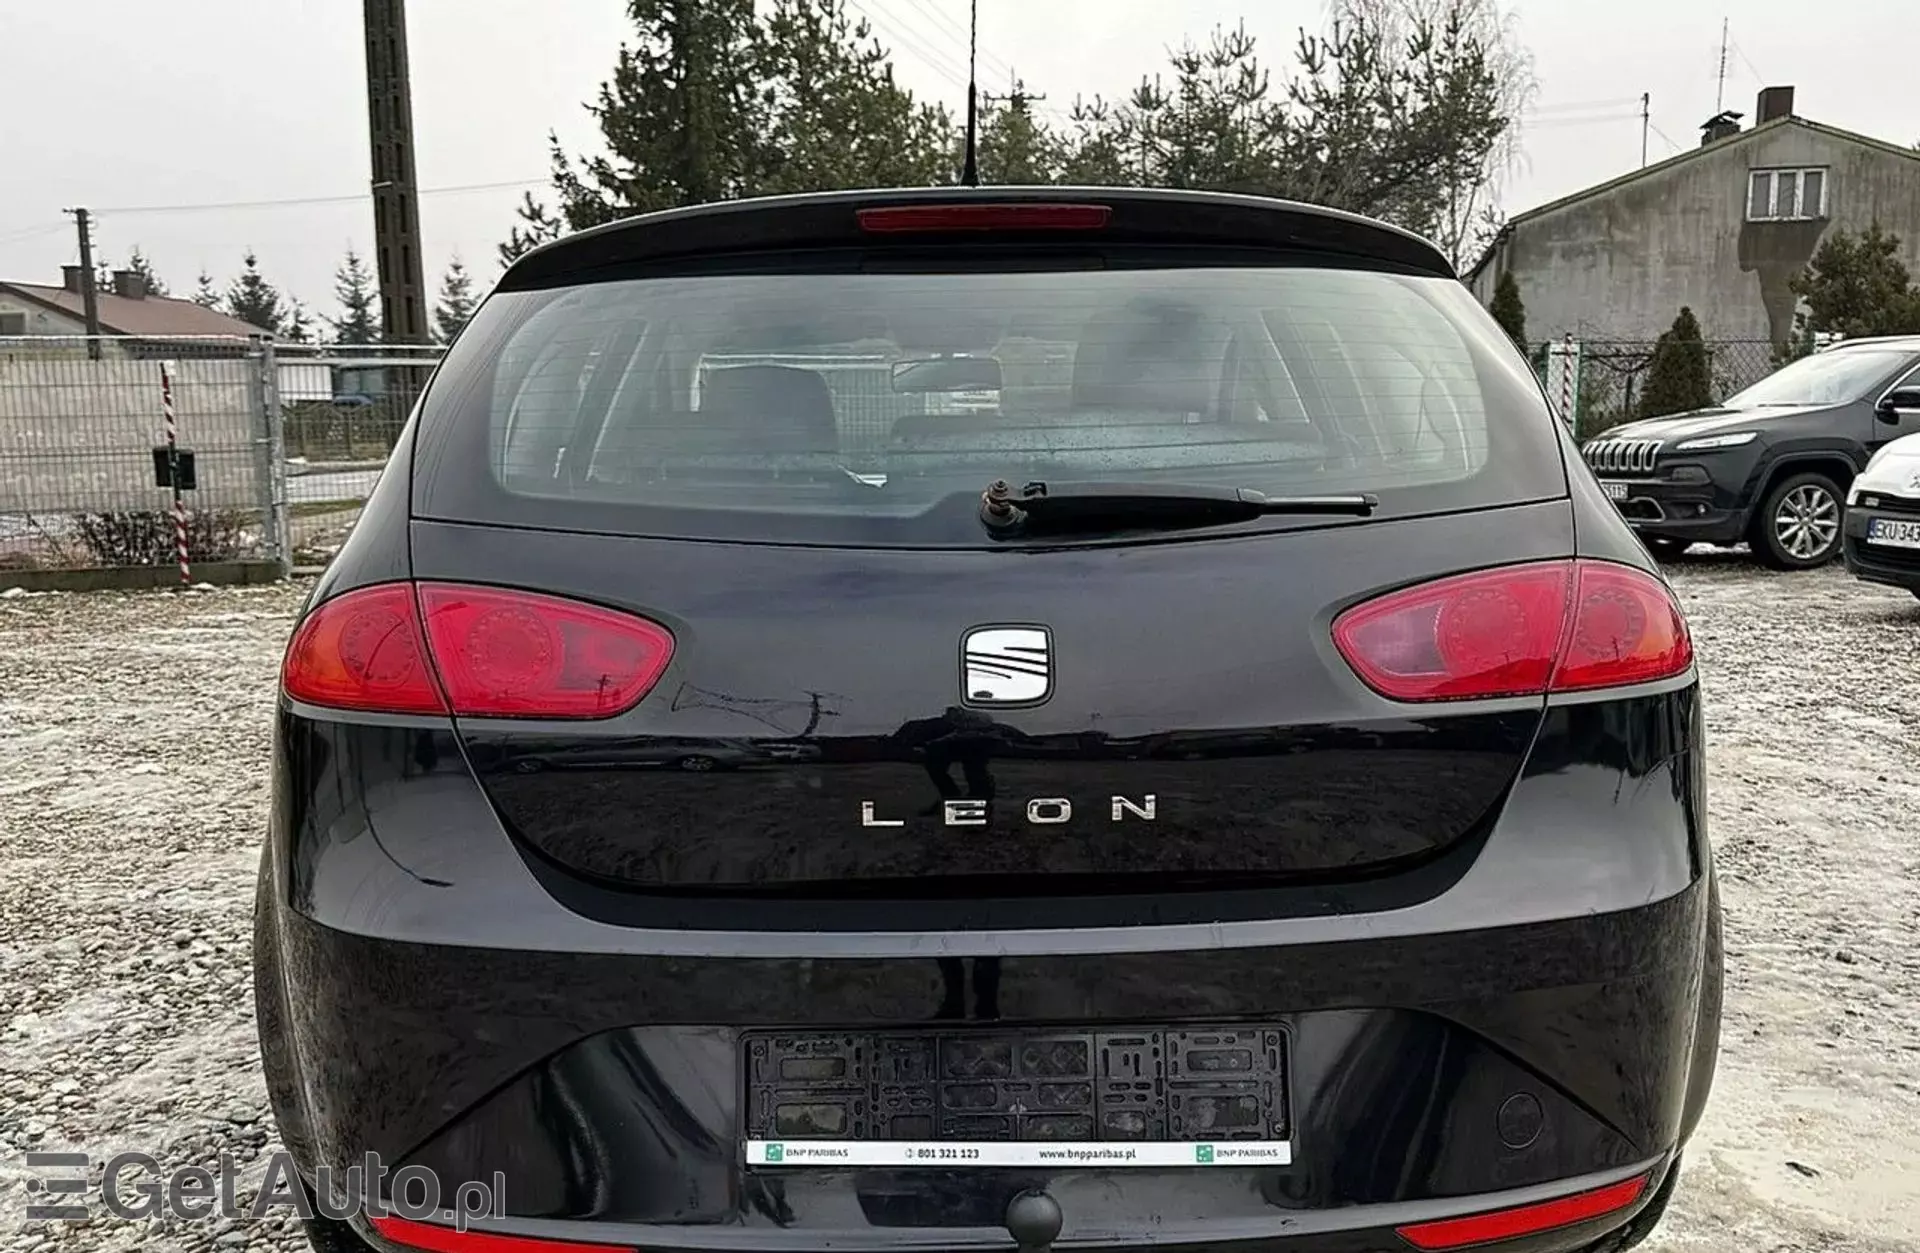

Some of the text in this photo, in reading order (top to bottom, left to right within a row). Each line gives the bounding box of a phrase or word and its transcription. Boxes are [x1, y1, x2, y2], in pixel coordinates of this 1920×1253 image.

[862, 794, 1157, 826] LEON
[786, 1149, 806, 1158] BNP
[917, 1148, 980, 1159] 801 321 123
[1039, 1148, 1136, 1161] www.bnpparibas.pl
[1216, 1149, 1236, 1158] BNP
